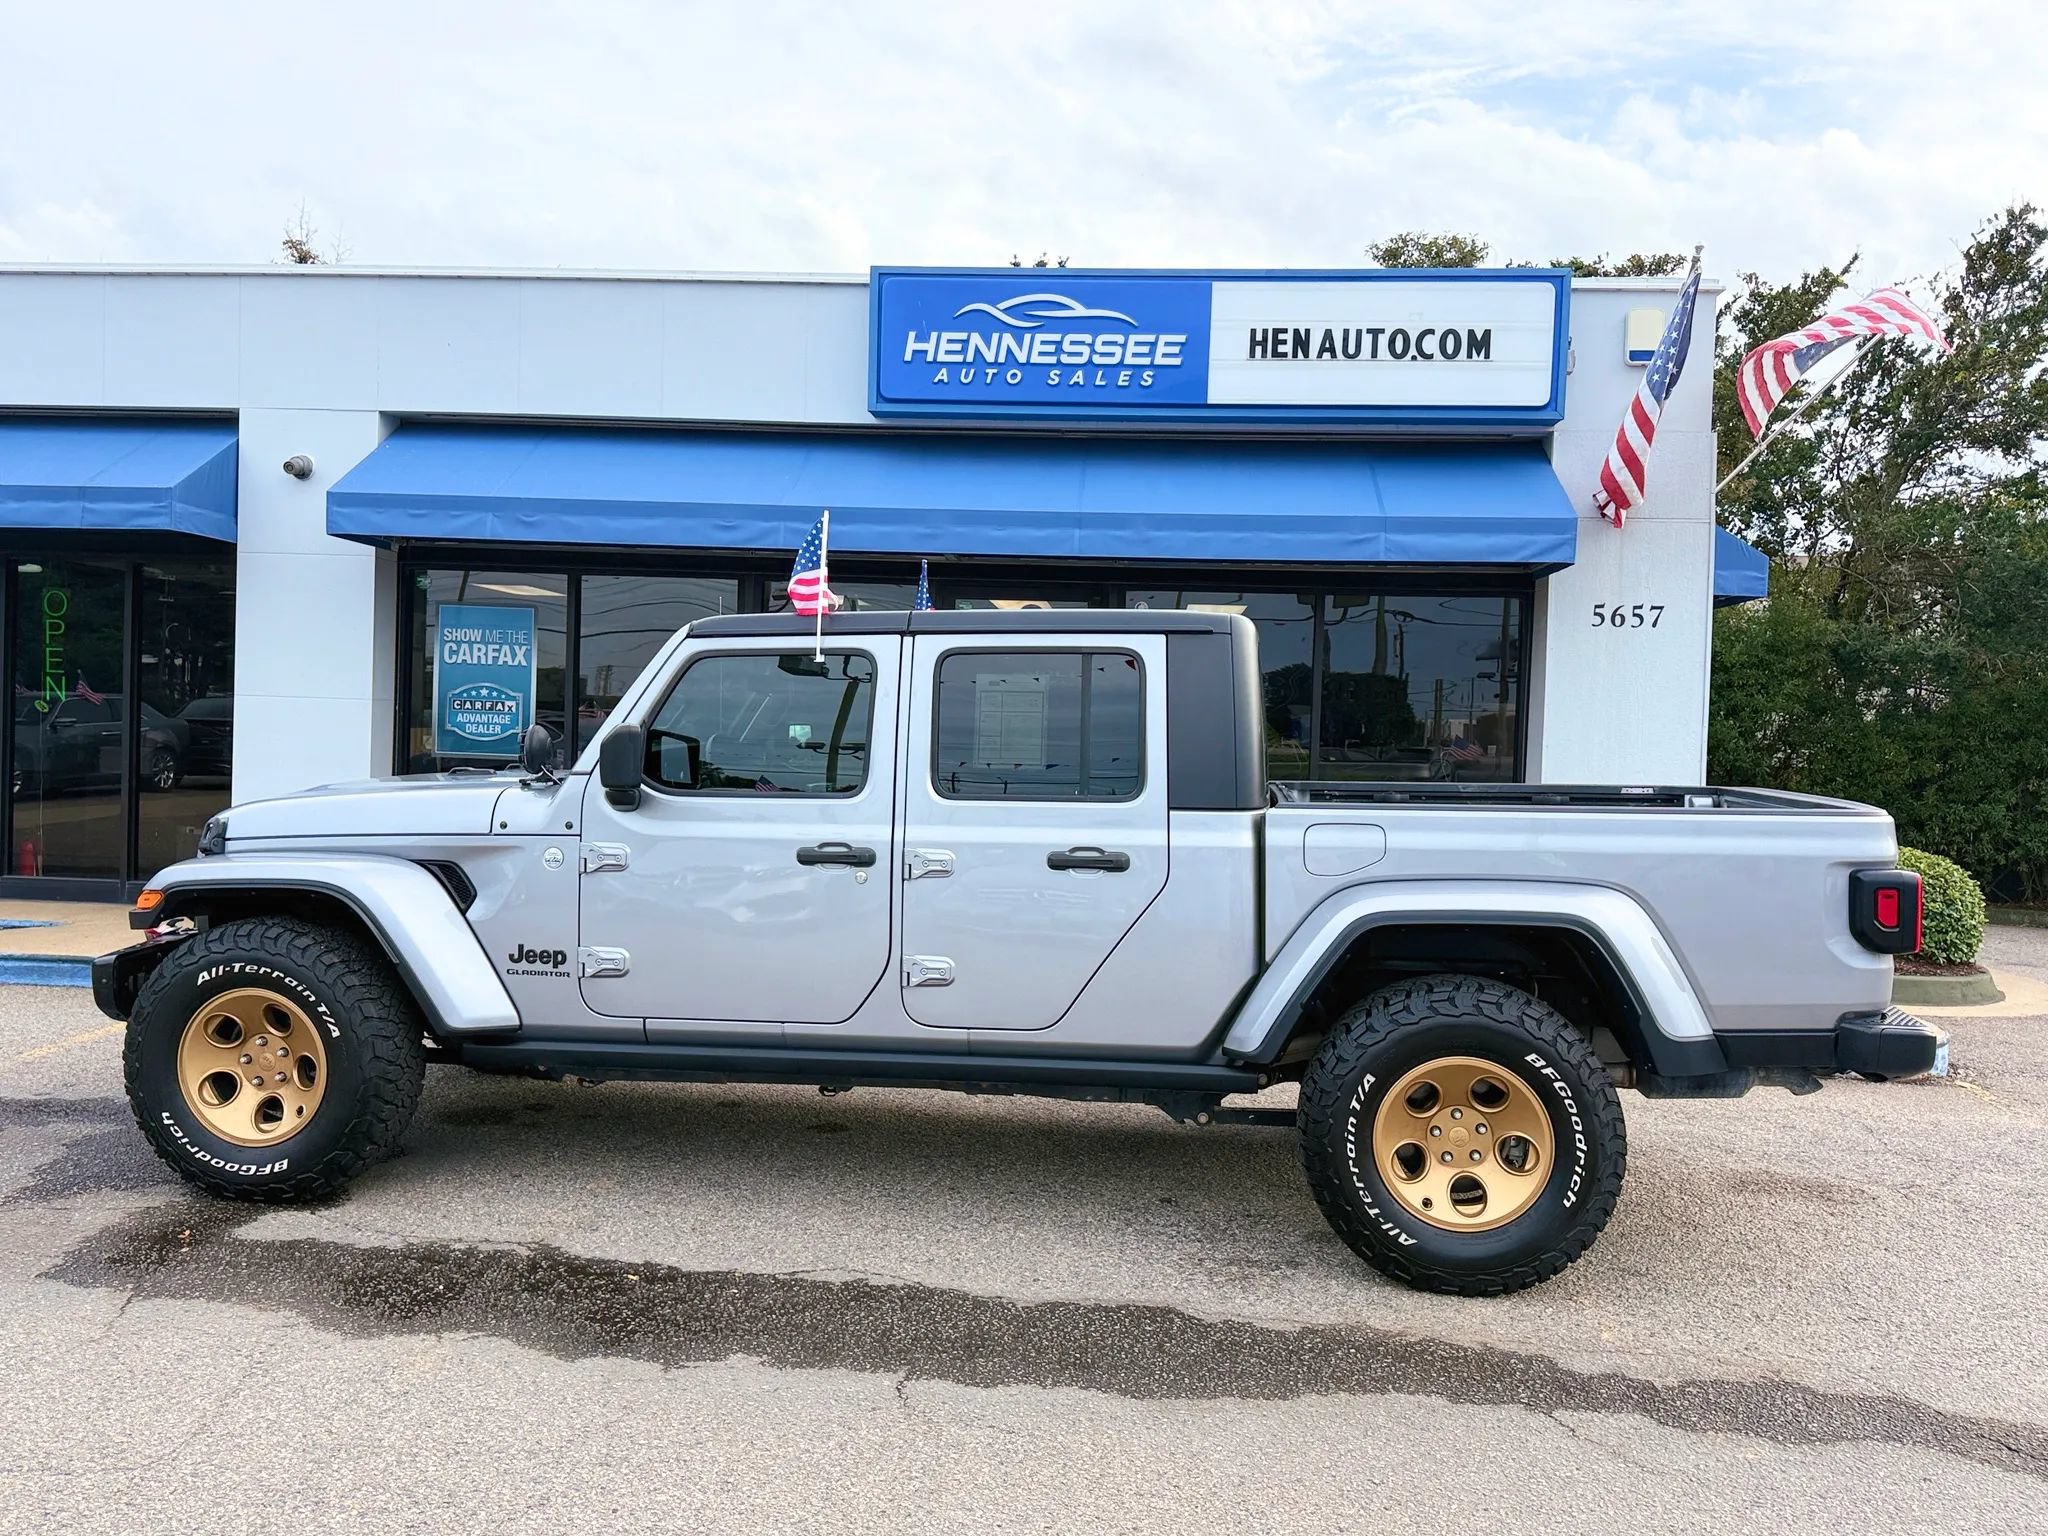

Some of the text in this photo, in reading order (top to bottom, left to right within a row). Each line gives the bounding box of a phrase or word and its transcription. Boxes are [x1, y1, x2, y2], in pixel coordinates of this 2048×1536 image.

[904, 331, 1187, 366] HENNESSEE
[933, 368, 1154, 386] AUTO SALES
[1591, 602, 1665, 628] 5657
[44, 590, 67, 702] OPEN
[443, 628, 529, 644] SHOW ME THE
[443, 643, 529, 666] CARFAX
[452, 699, 516, 712] CARFAX
[456, 713, 511, 725] ADVANTAGE
[465, 723, 501, 734] DEALER
[508, 943, 567, 969] Jeep
[196, 962, 316, 1002] All-Terrain
[506, 968, 571, 978] GLADIATOR
[161, 1111, 289, 1176] BFGoodrich
[1524, 1052, 1588, 1209] BFGoodrich
[1343, 1118, 1418, 1246] All-Terrain
